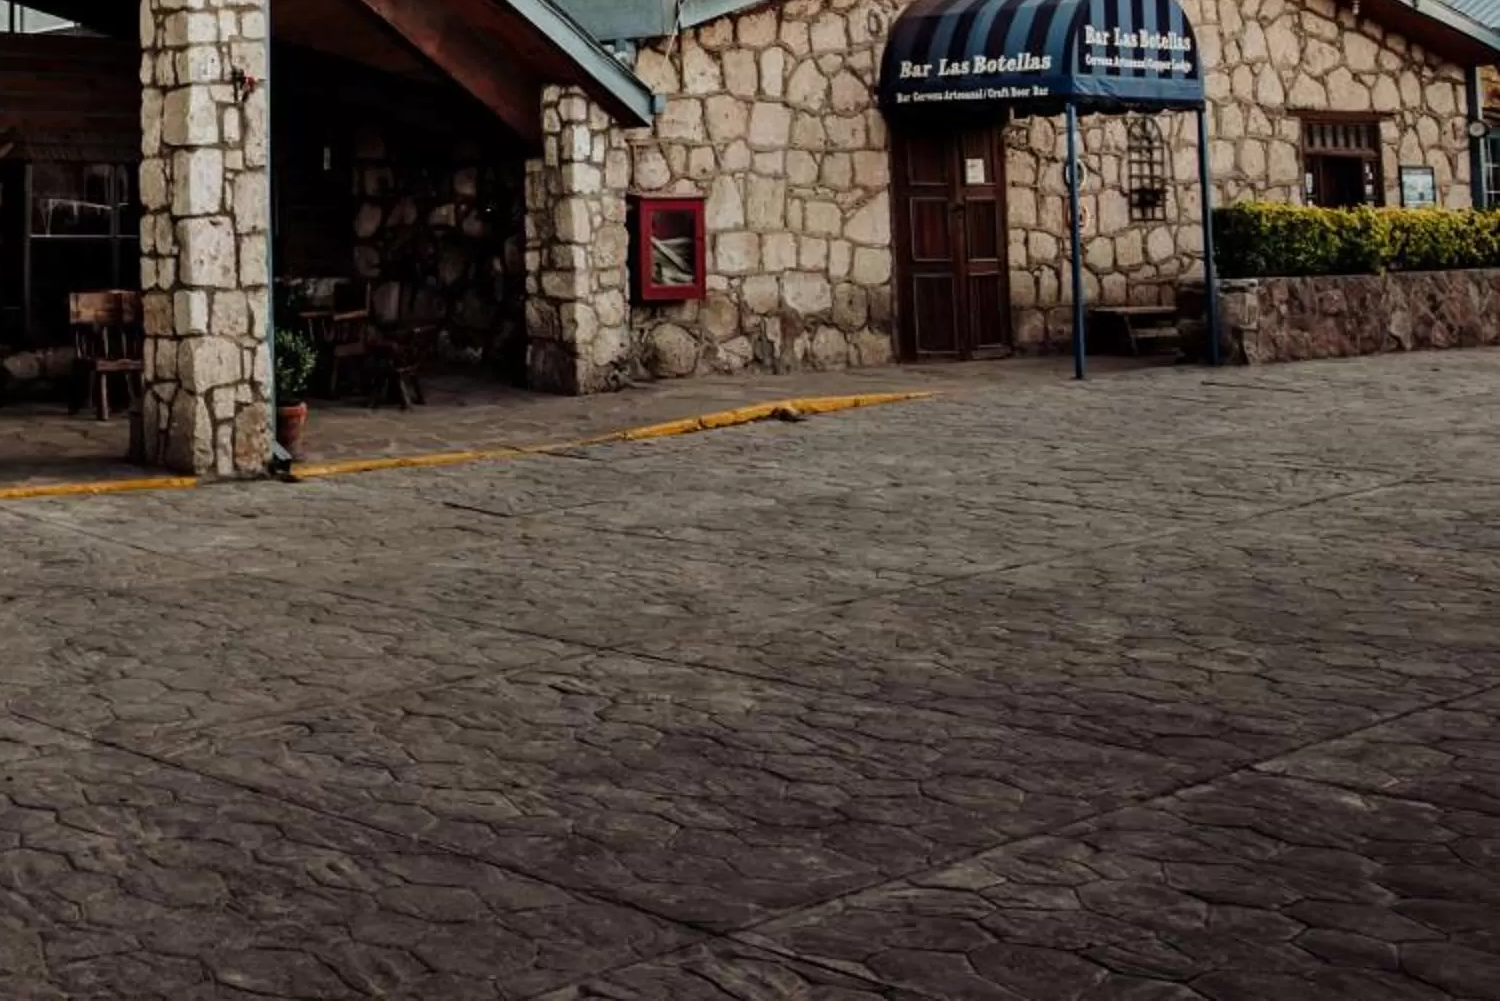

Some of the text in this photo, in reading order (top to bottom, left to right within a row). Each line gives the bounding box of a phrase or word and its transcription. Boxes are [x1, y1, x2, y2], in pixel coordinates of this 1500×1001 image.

[1085, 25, 1191, 51] Bar Las Botellas
[900, 52, 1052, 78] Bar Las Botellas
